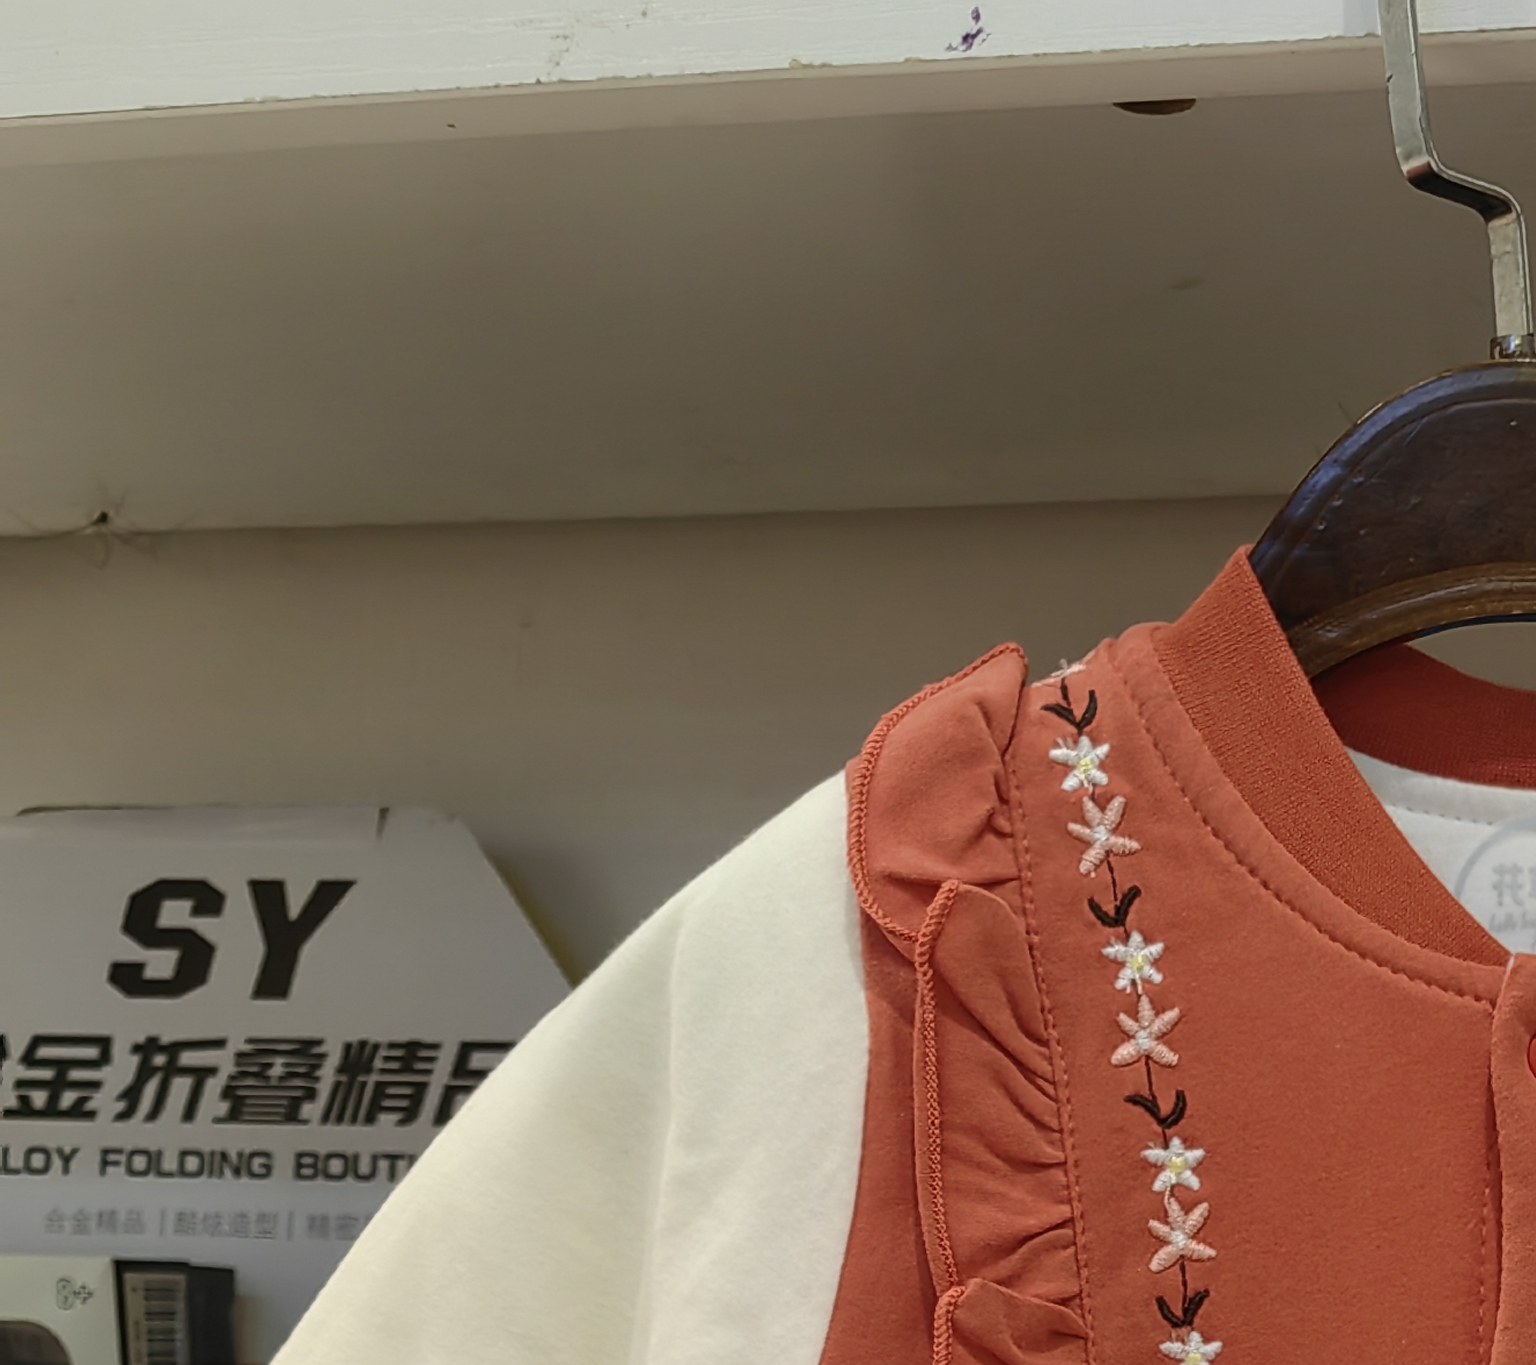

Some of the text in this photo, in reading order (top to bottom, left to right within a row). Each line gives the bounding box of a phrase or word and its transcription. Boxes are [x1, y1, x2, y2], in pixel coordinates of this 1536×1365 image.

[107, 877, 357, 1001] SY
[0, 1034, 517, 1128] 金折叠精品
[99, 1148, 274, 1180] FOLDING
